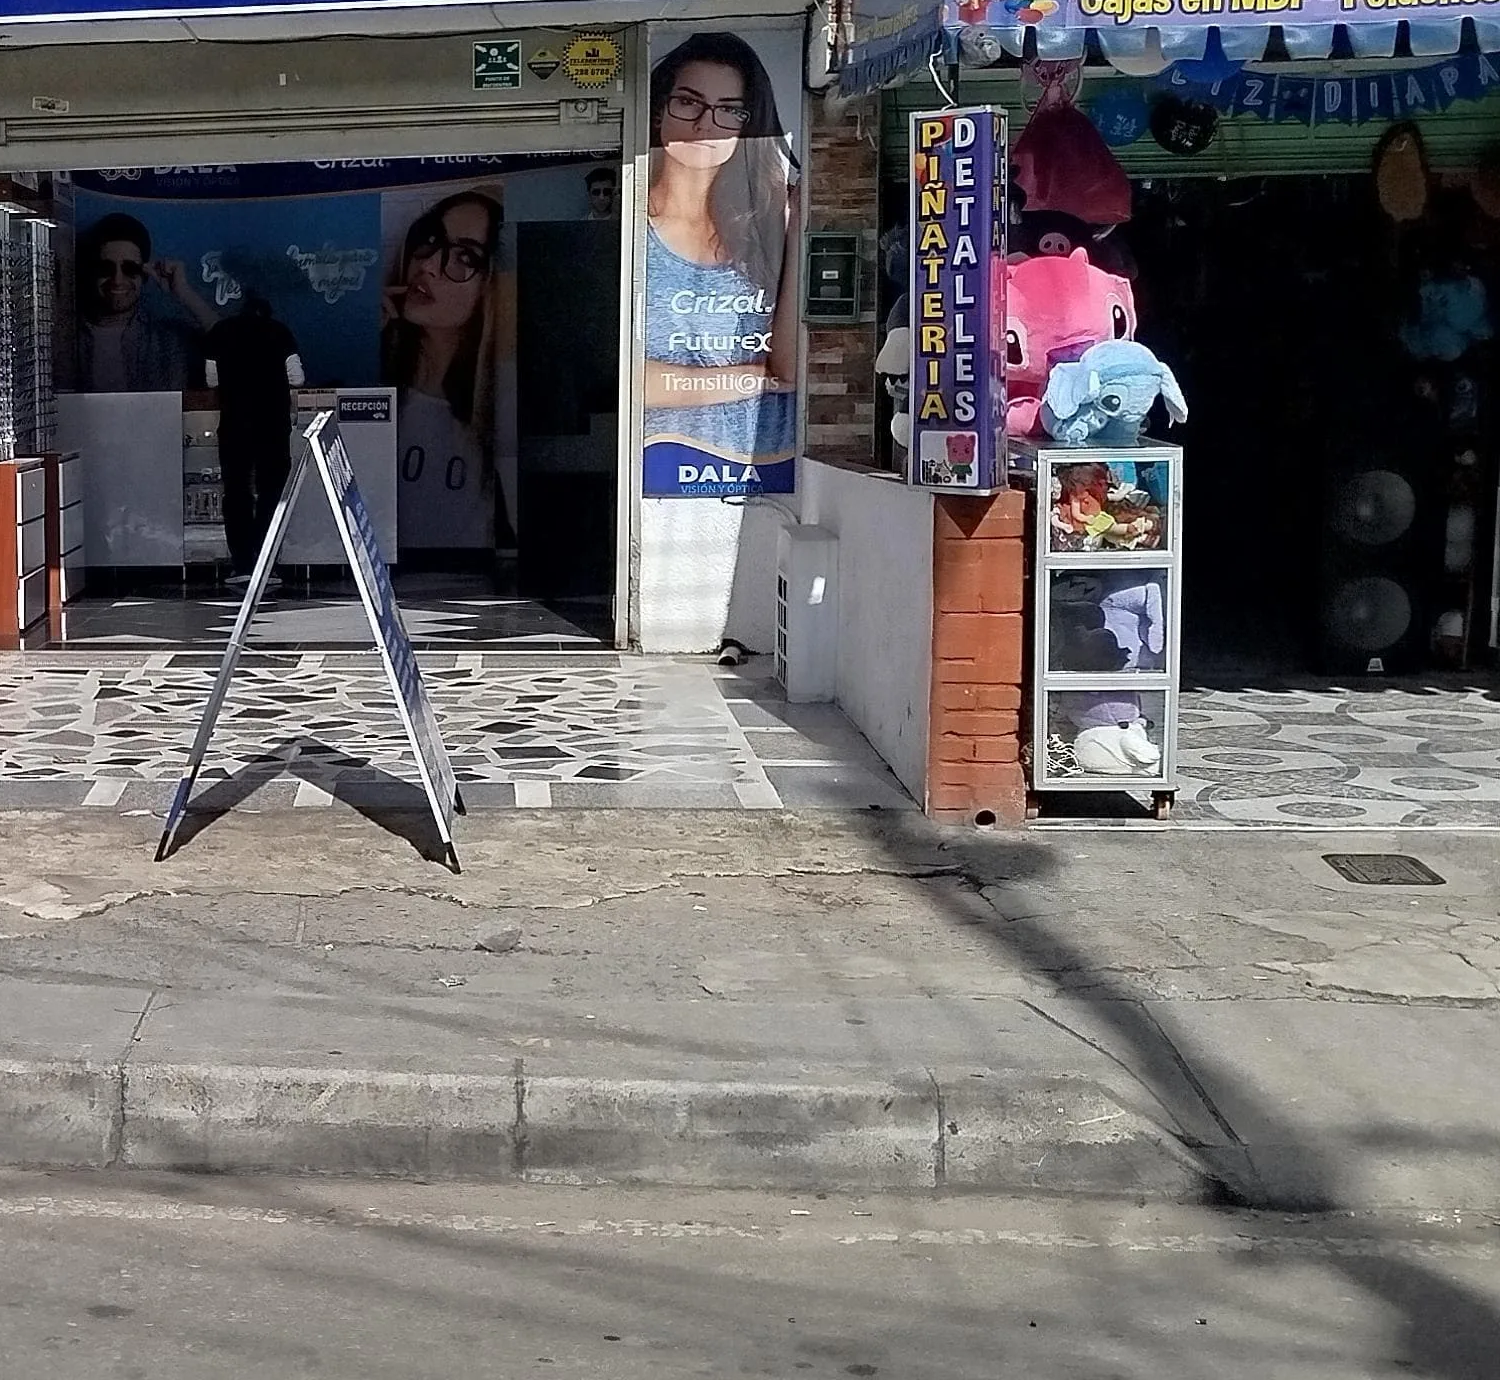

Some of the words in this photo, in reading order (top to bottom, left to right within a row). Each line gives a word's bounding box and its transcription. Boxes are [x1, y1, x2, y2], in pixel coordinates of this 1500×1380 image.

[919, 121, 949, 420] PIÑATERIA
[952, 117, 978, 422] DETALLES
[678, 465, 762, 483] DALA
